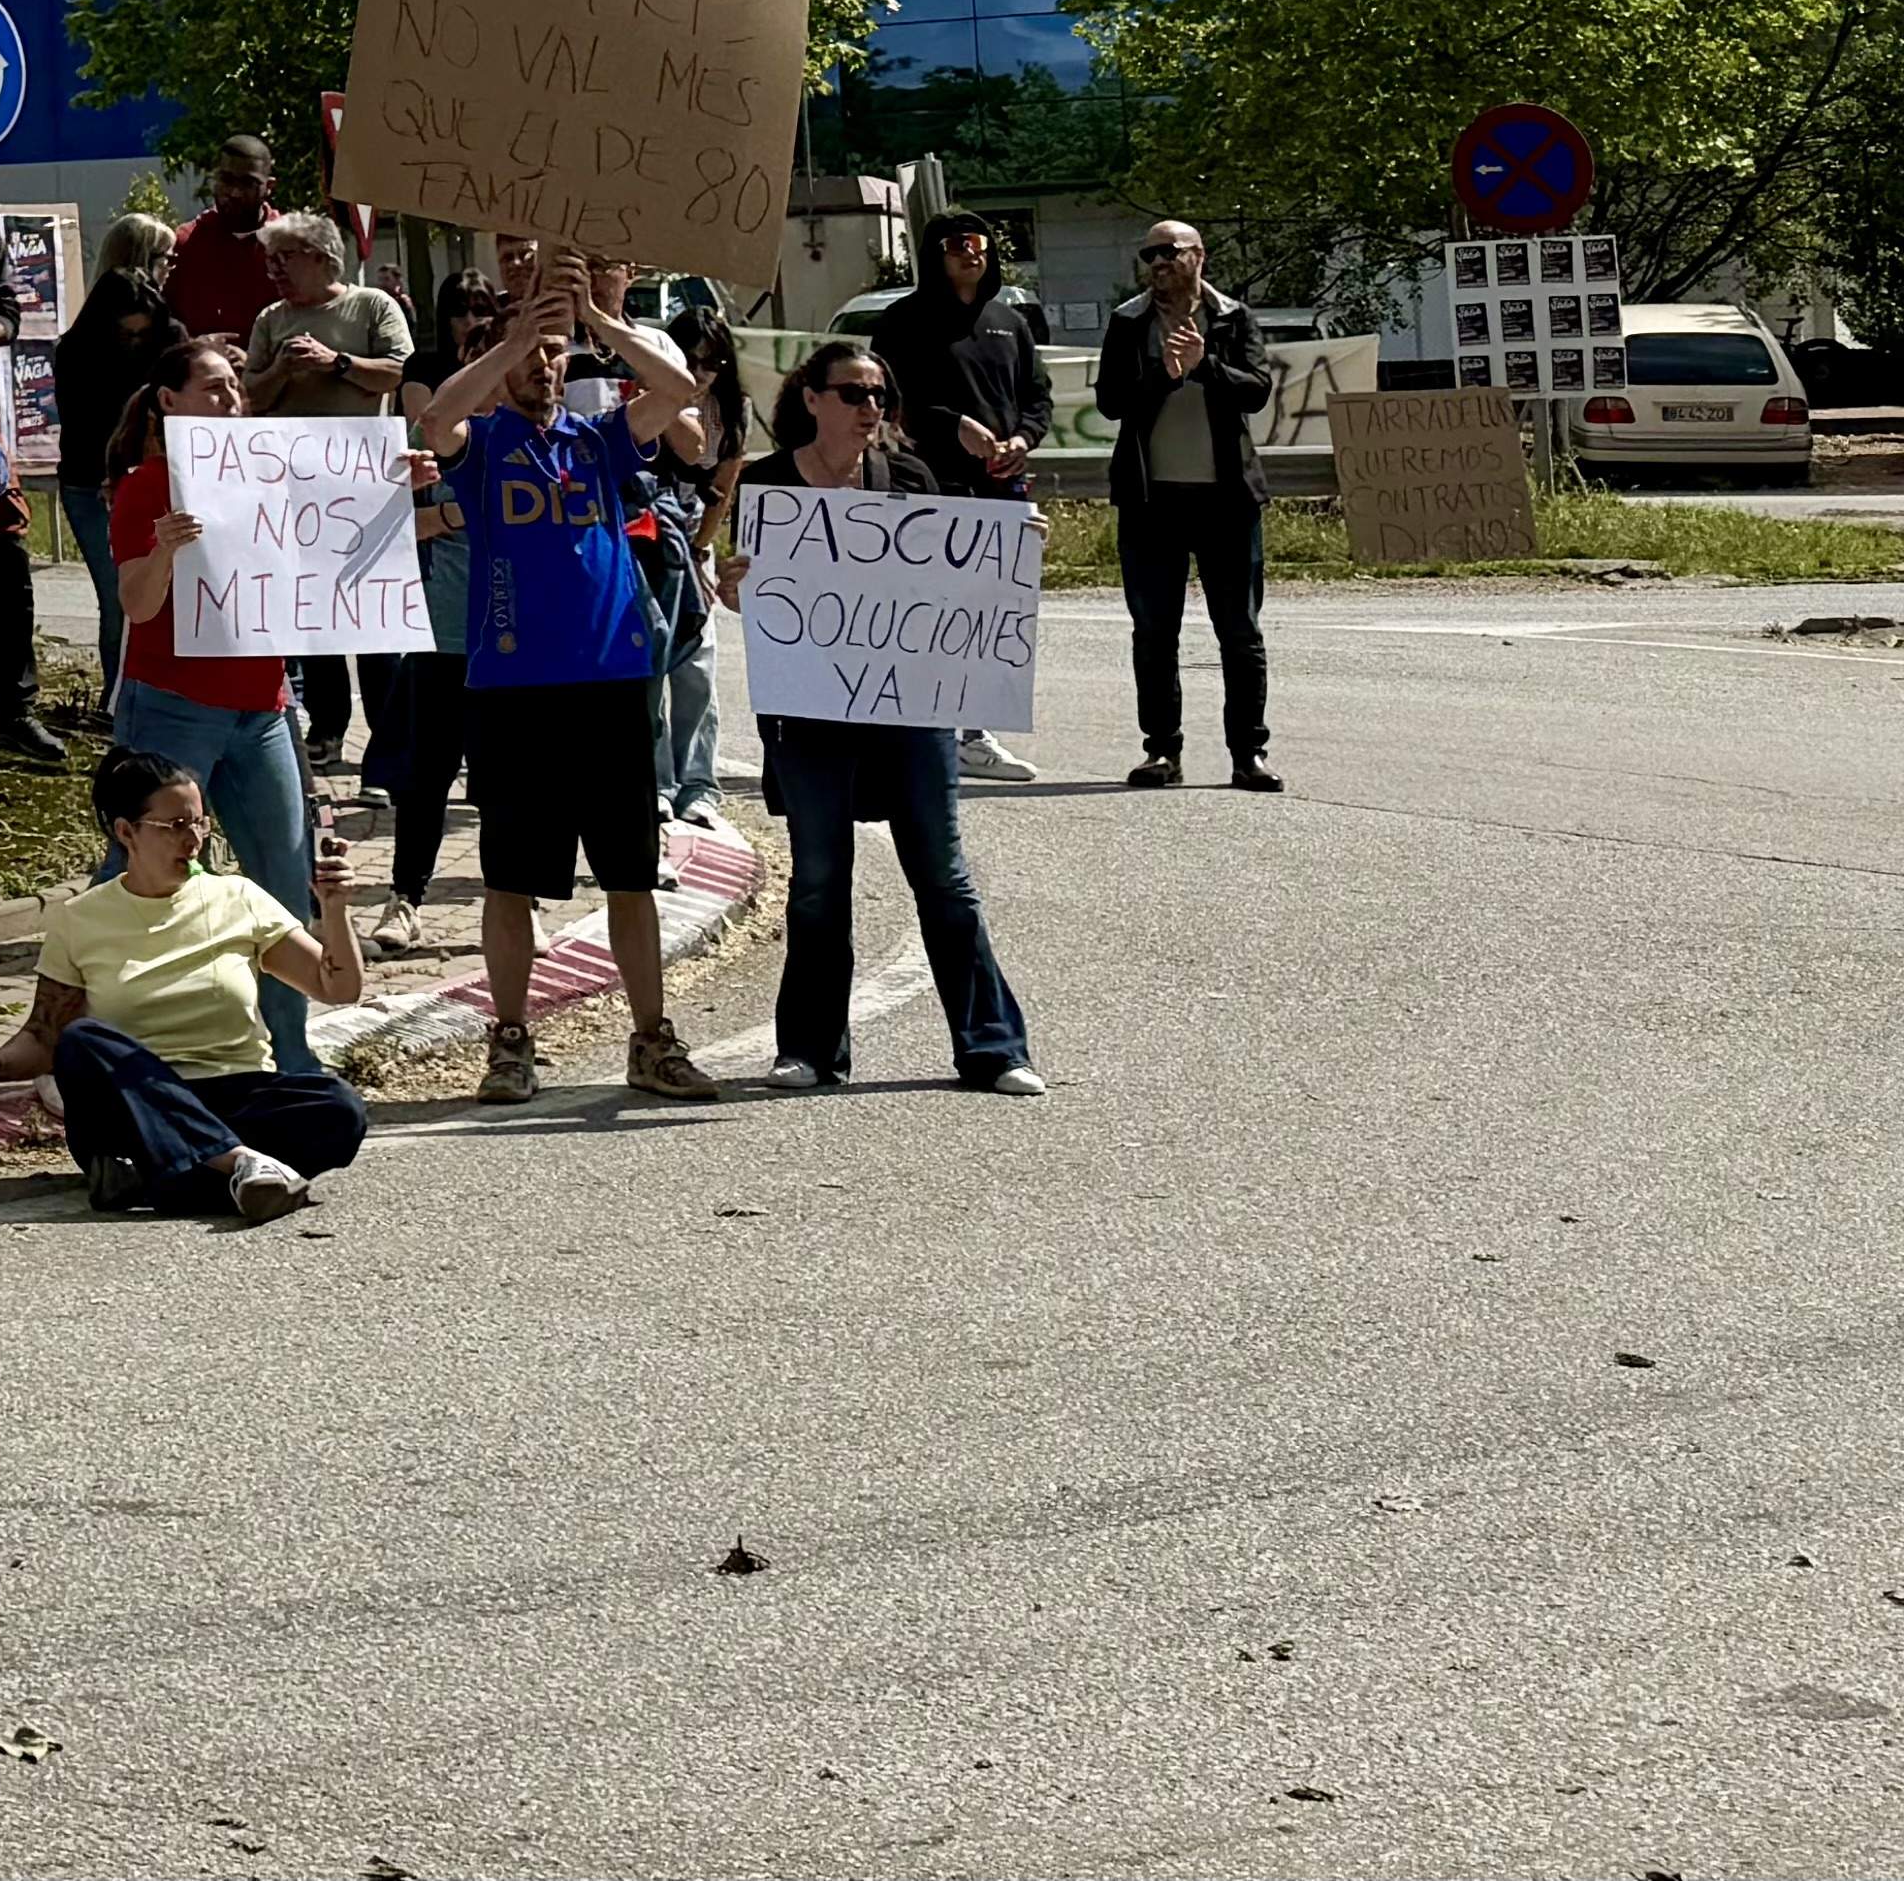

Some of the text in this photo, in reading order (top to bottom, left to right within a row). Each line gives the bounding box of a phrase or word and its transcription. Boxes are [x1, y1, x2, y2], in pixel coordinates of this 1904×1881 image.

[514, 24, 609, 94] VAL
[382, 78, 480, 150] QUE
[597, 125, 668, 185] DE
[685, 146, 770, 234] 80
[190, 426, 406, 486] PASCUAL
[1340, 442, 1503, 483] QUEREMOS
[254, 497, 364, 555] NOS
[1347, 479, 1525, 516] CONTRATOS
[1379, 518, 1533, 560] DIGNOS
[195, 569, 428, 639] MIENTE
